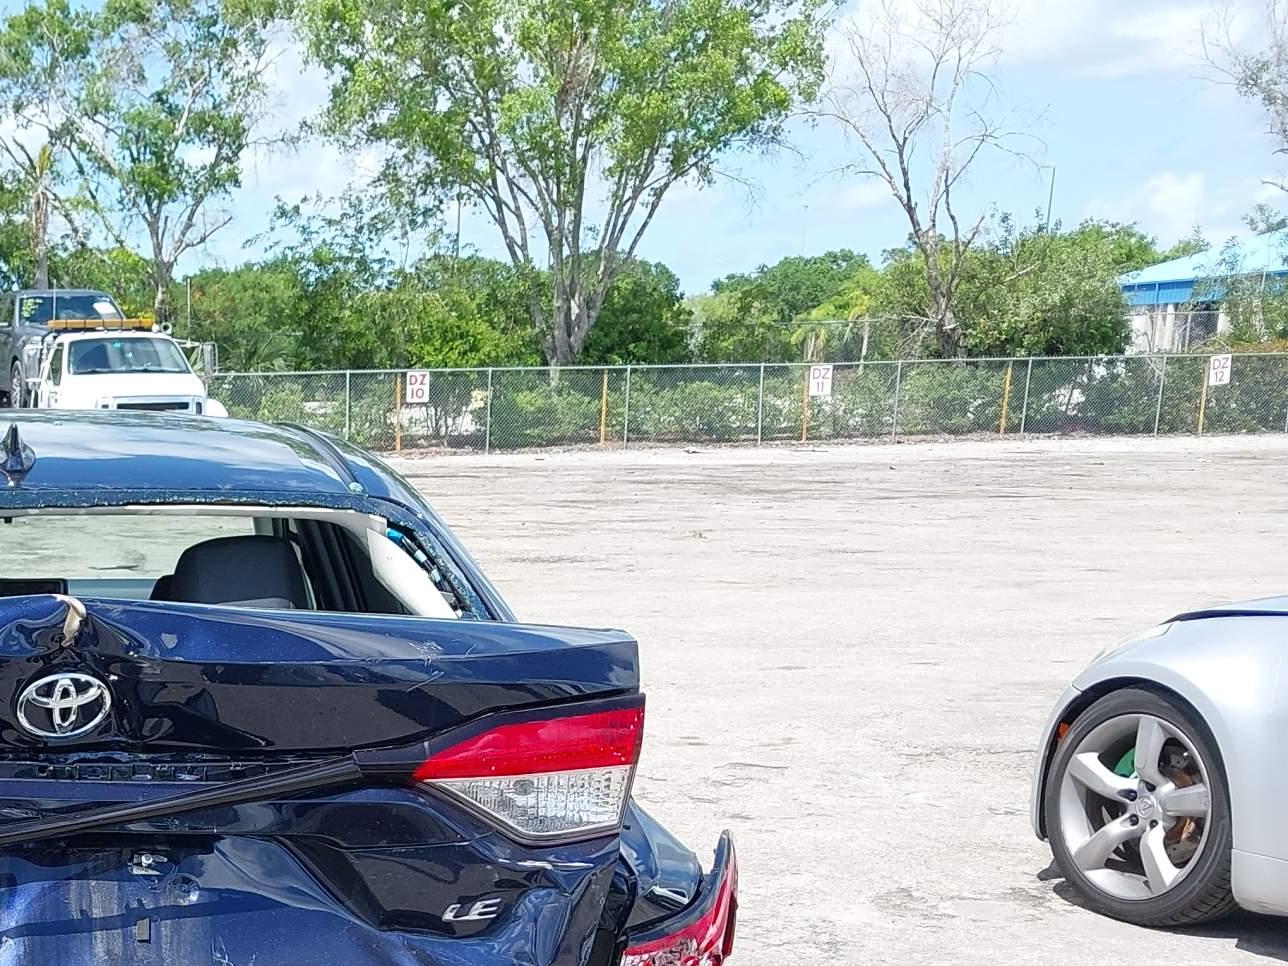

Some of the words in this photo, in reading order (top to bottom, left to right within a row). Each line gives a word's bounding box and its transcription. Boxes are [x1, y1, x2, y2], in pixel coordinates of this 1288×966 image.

[1212, 358, 1229, 370] DZ
[812, 367, 831, 380] DZ
[1215, 371, 1225, 382] 12
[409, 374, 427, 386] DZ
[410, 387, 425, 399] 10
[441, 897, 503, 923] LE
